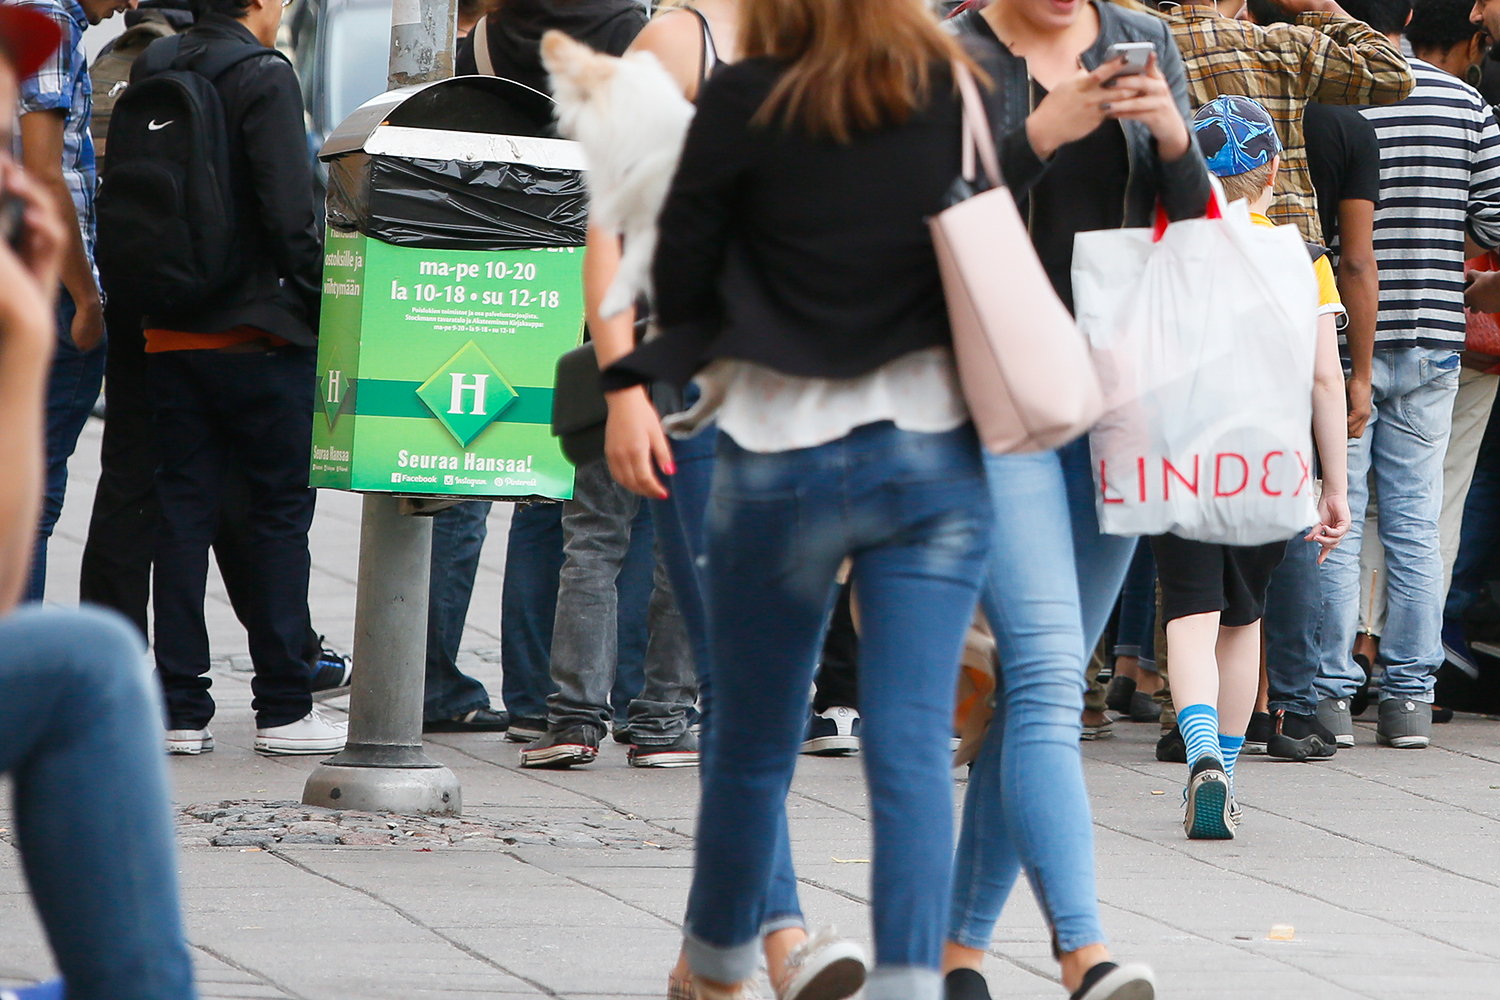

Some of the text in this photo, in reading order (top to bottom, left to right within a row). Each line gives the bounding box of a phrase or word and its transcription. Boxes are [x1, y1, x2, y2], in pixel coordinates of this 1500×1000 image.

[354, 251, 363, 272] ja
[419, 260, 537, 282] ma-pe 10-20
[391, 280, 559, 308] la 10-18 su 12-18
[405, 314, 436, 322] Stockmann
[327, 370, 341, 403] H
[447, 372, 490, 416] H
[397, 449, 533, 473] Seuraa Hansaa!
[402, 474, 538, 487] Facebook Instagram Pinterest
